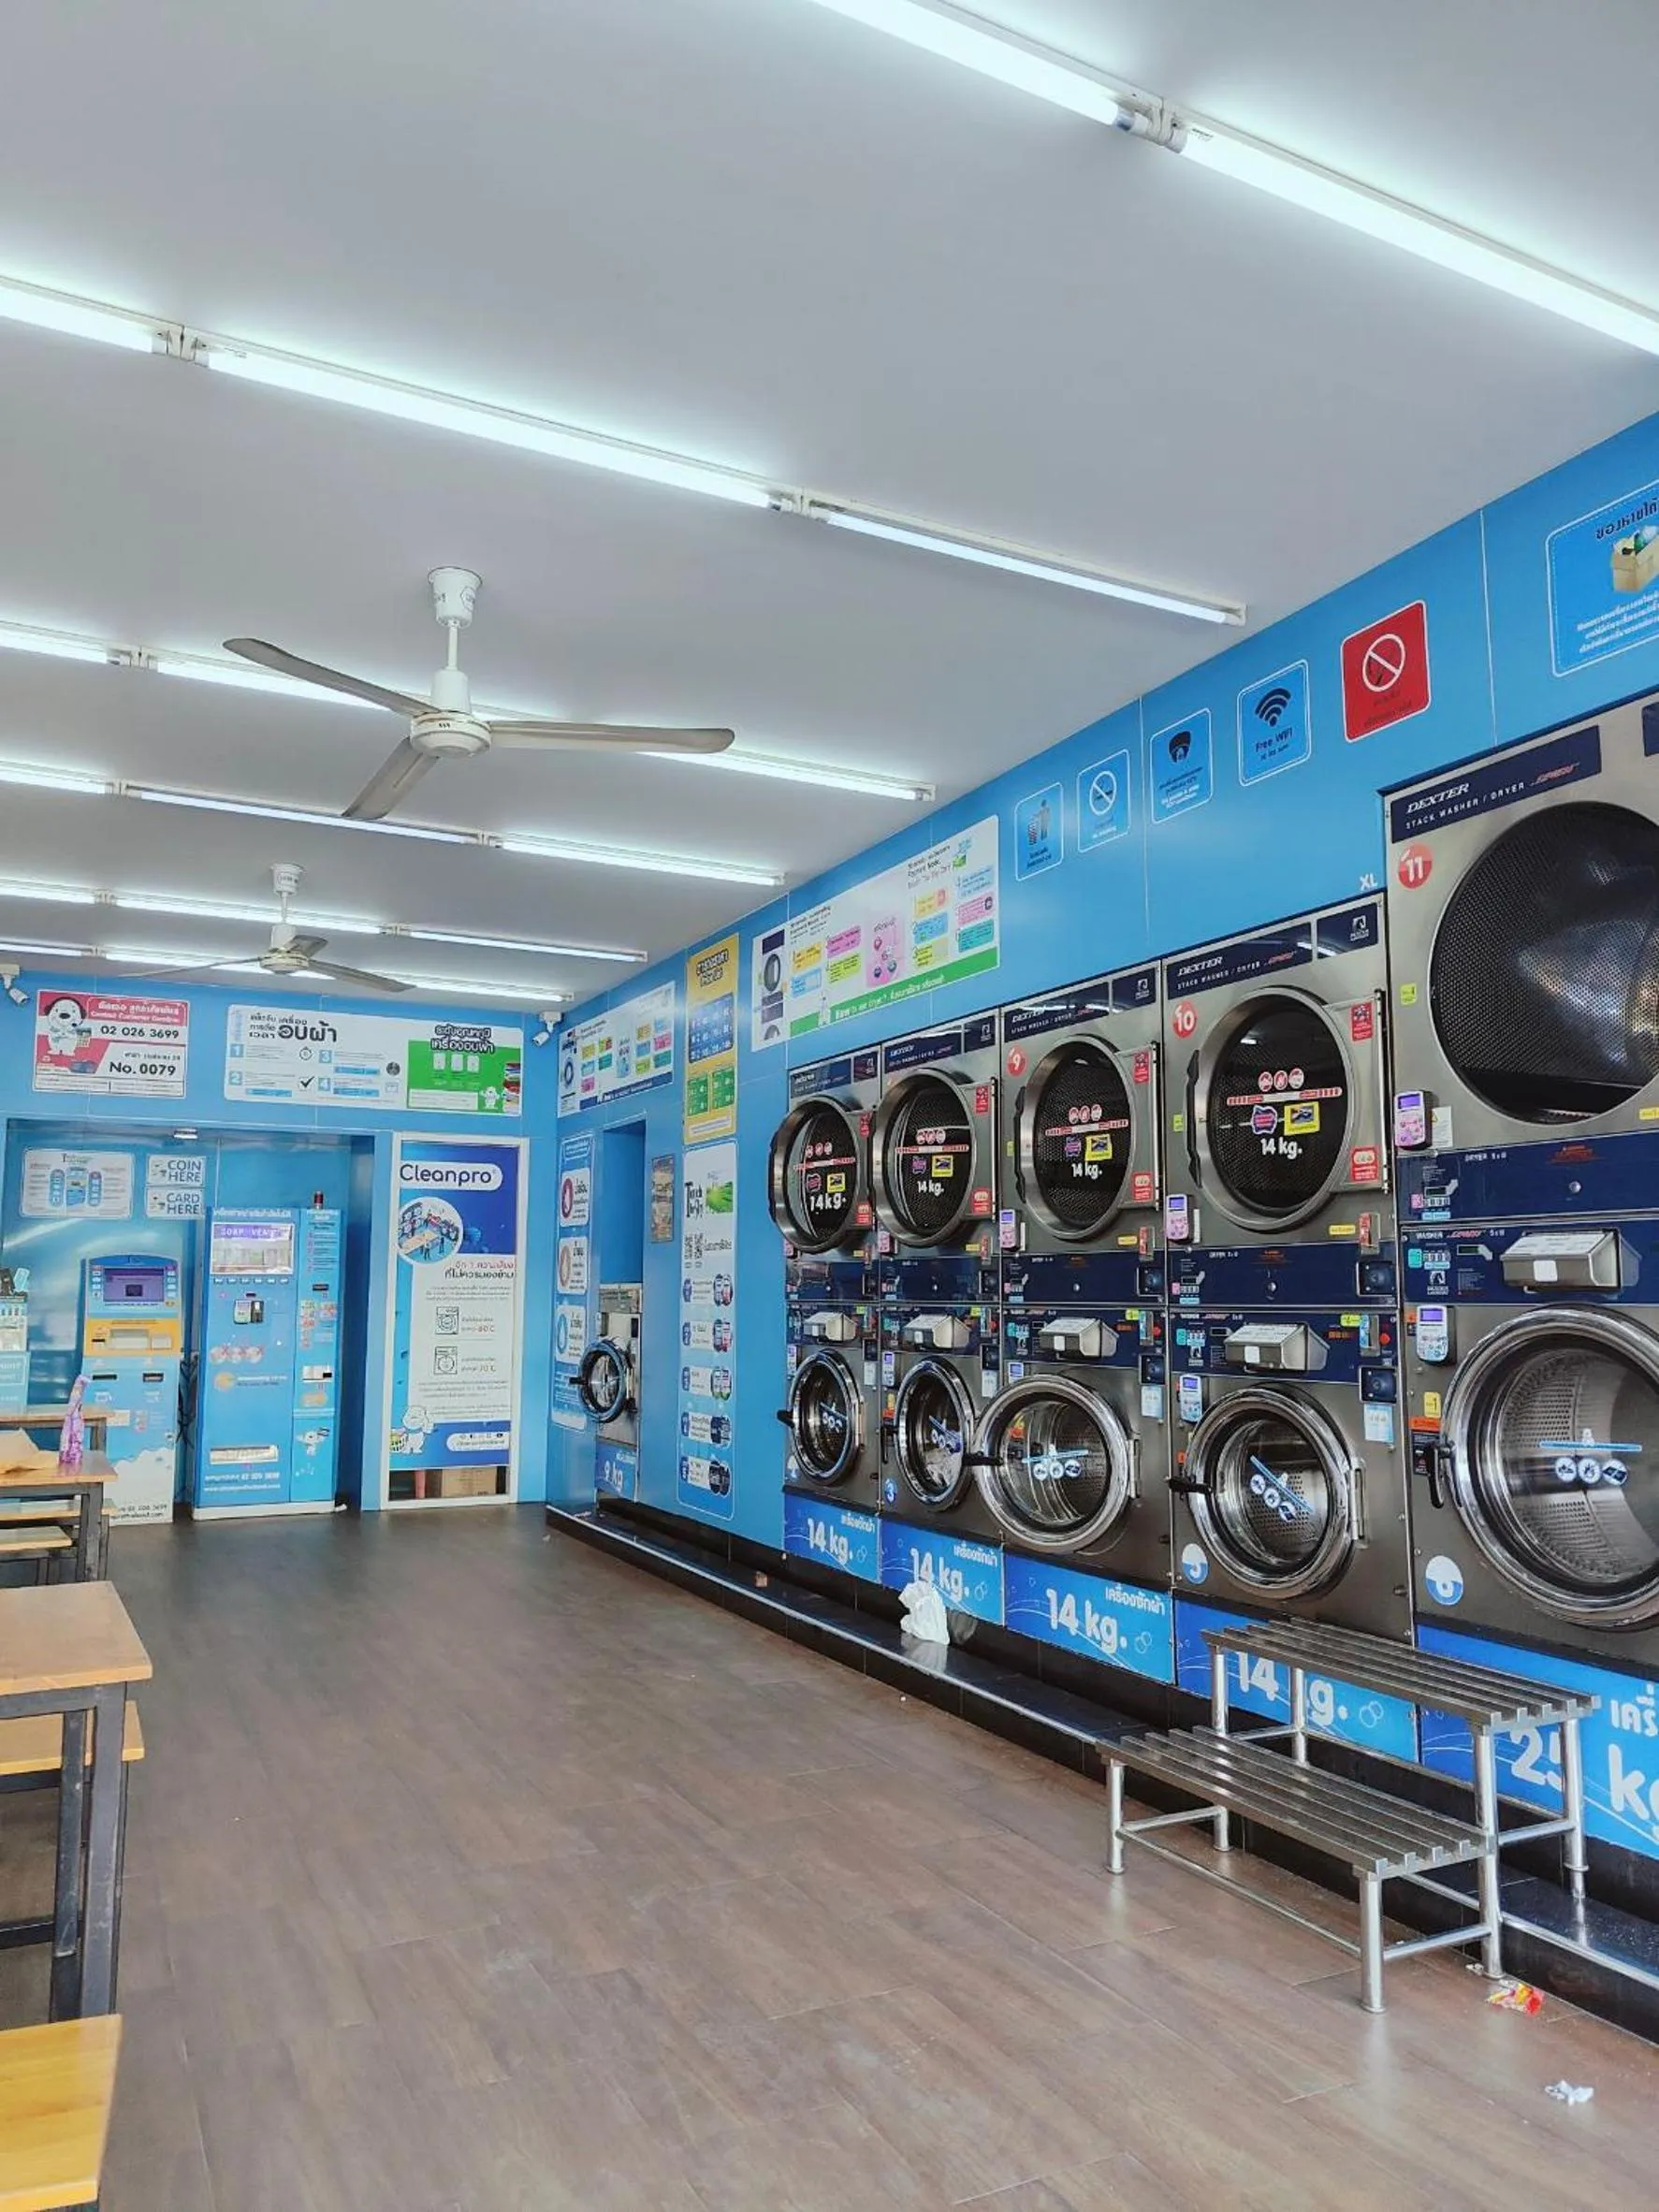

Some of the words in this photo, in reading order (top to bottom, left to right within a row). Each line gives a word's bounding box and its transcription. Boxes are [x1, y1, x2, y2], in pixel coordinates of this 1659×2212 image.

[1256, 739, 1273, 752] Free
[1405, 815, 1434, 829] STACK
[1440, 798, 1479, 821] WASHER
[1491, 781, 1525, 800] DRYER
[1406, 782, 1469, 814] DEXTER
[1405, 855, 1423, 882] 11
[1360, 873, 1377, 890] XL
[278, 1019, 337, 1042] อบผ้า
[1177, 1011, 1195, 1030] 10
[100, 1026, 117, 1035] 02
[122, 1027, 145, 1037] 026
[150, 1029, 179, 1039] 3699
[109, 1061, 137, 1075] No.
[139, 1063, 176, 1075] 0079
[1012, 1054, 1021, 1071] 9
[1260, 1138, 1276, 1156] 14
[1278, 1136, 1303, 1160] kg.
[167, 1160, 201, 1171] COIN
[400, 1164, 492, 1186] Cleanpro
[1071, 1163, 1083, 1177] 14
[1084, 1160, 1103, 1180] kg.
[168, 1171, 201, 1183] HERE
[917, 1180, 927, 1193] 14
[928, 1178, 944, 1197] kg.
[166, 1193, 200, 1203] CARD
[809, 1195, 823, 1212] 14
[824, 1192, 847, 1210] kg.
[167, 1204, 200, 1215] HERE
[808, 1517, 827, 1552] 14
[829, 1525, 853, 1566] kg.
[910, 1548, 935, 1585] 14
[939, 1557, 970, 1602] kg.
[1105, 1583, 1165, 1616] เครื่องซักผ้า
[1045, 1589, 1079, 1636] 14
[1084, 1599, 1128, 1654] kg.
[1235, 1651, 1280, 1701] 14
